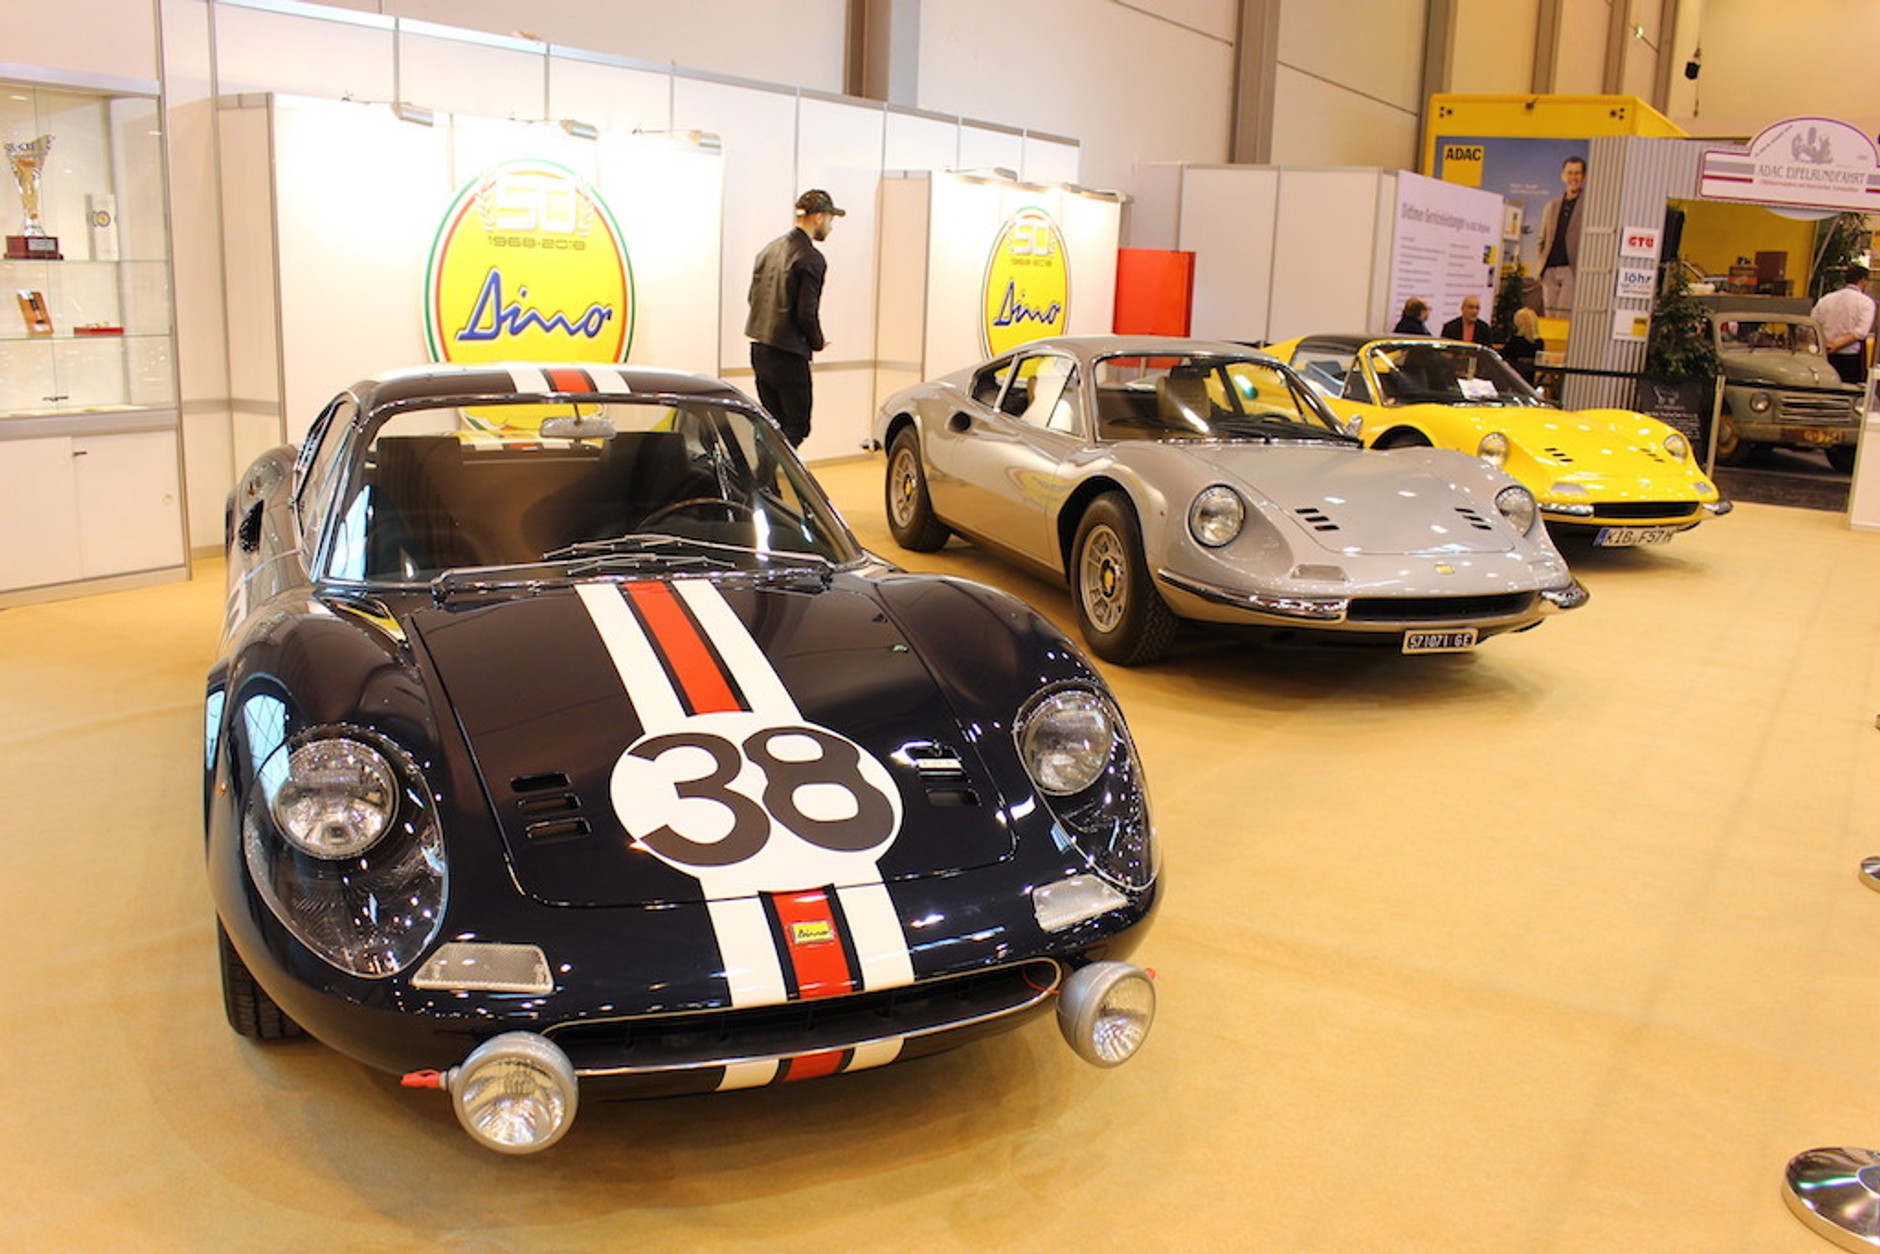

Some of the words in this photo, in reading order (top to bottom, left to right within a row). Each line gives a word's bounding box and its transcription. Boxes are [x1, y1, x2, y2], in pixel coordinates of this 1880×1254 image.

[1445, 147, 1482, 161] ADAC
[1758, 164, 1785, 178] ADAC
[495, 175, 577, 234] 50
[488, 235, 587, 250] 1968-2018
[1012, 220, 1049, 256] 50
[455, 267, 613, 342] Dino
[993, 281, 1062, 326] Dino
[626, 726, 895, 868] 38
